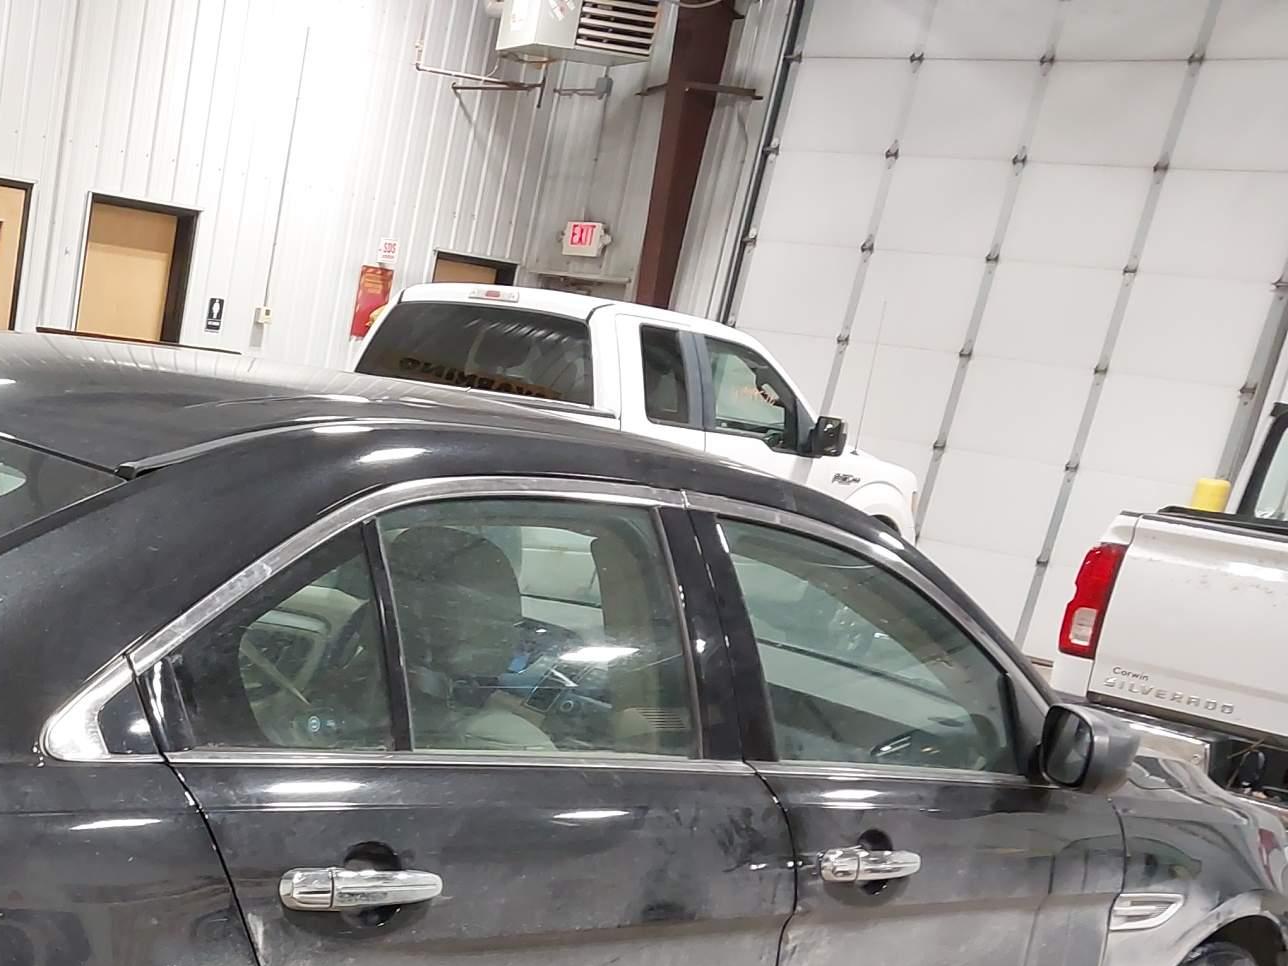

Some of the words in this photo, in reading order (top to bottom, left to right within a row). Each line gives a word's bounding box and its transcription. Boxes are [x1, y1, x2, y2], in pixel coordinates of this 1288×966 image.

[571, 224, 596, 246] EXIT
[1112, 666, 1149, 681] Corwin
[1103, 676, 1235, 715] SILVERADO
